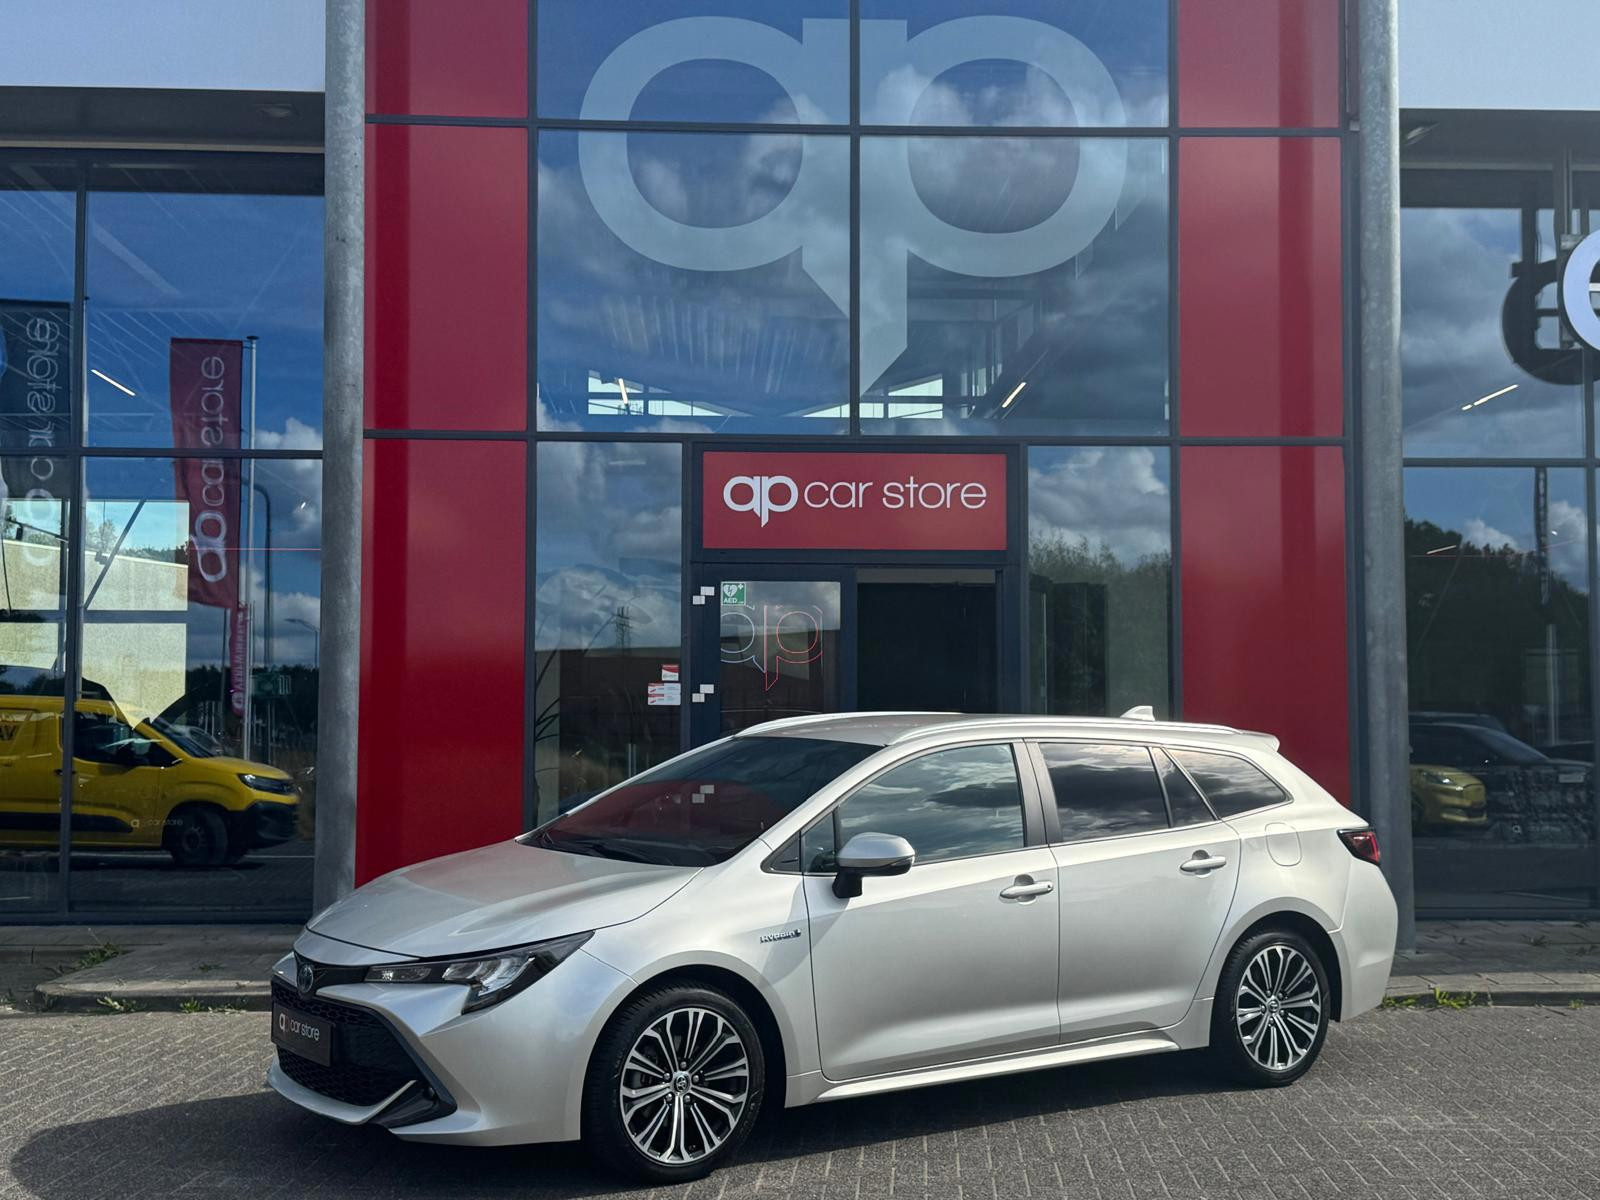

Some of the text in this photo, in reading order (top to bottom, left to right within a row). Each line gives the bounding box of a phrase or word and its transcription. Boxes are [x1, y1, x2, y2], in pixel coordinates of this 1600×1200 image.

[578, 15, 1128, 398] ap
[723, 475, 987, 527] ap car store
[290, 1019, 301, 1033] car
[301, 1023, 320, 1041] store
